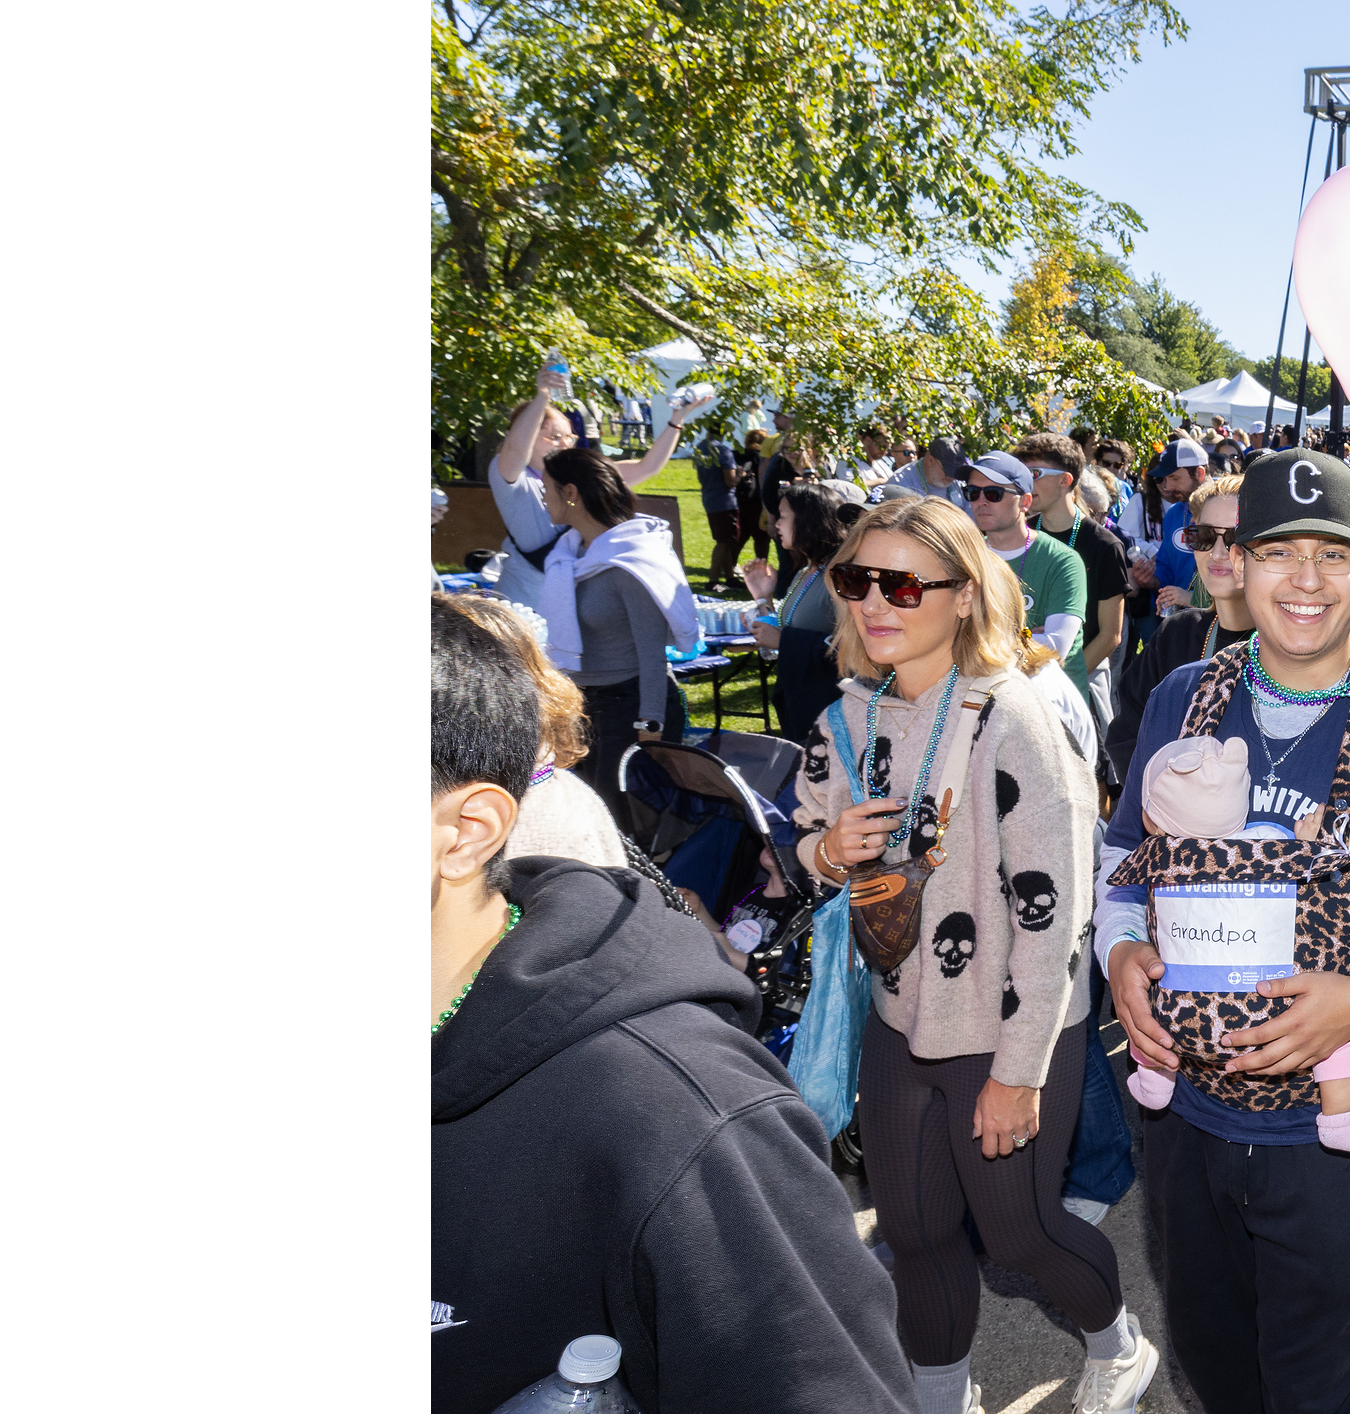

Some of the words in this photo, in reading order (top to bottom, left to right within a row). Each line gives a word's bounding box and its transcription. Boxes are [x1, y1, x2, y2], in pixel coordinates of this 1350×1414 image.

[1288, 460, 1323, 504] C
[1253, 785, 1319, 821] WITH
[1184, 880, 1255, 897] Walking
[1260, 880, 1289, 893] For
[1171, 921, 1257, 945] Grandpa
